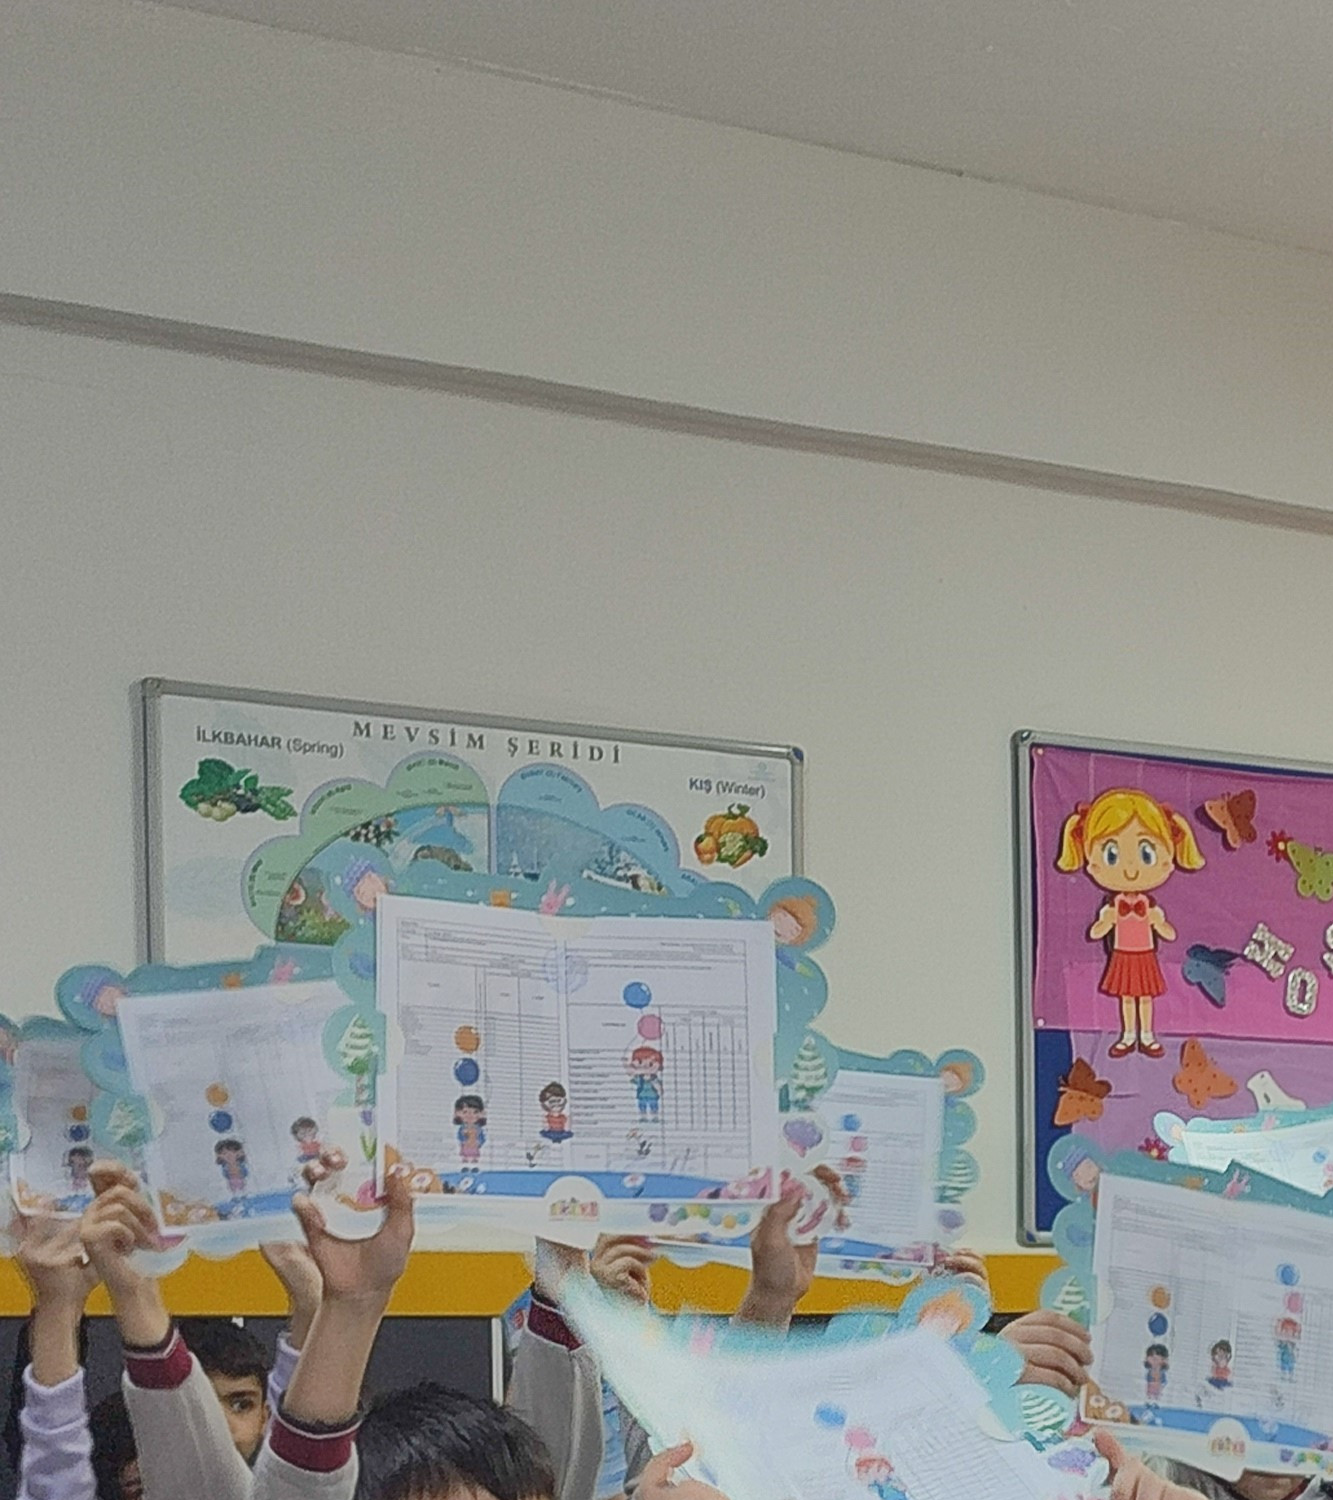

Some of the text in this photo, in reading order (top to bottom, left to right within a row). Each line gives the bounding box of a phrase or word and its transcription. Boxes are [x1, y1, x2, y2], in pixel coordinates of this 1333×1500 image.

[195, 726, 344, 759] İLKBAHAR (Spring)
[351, 720, 622, 764] MEVSİM ŞERİDİ
[688, 776, 766, 800] KIŞ (Winter)
